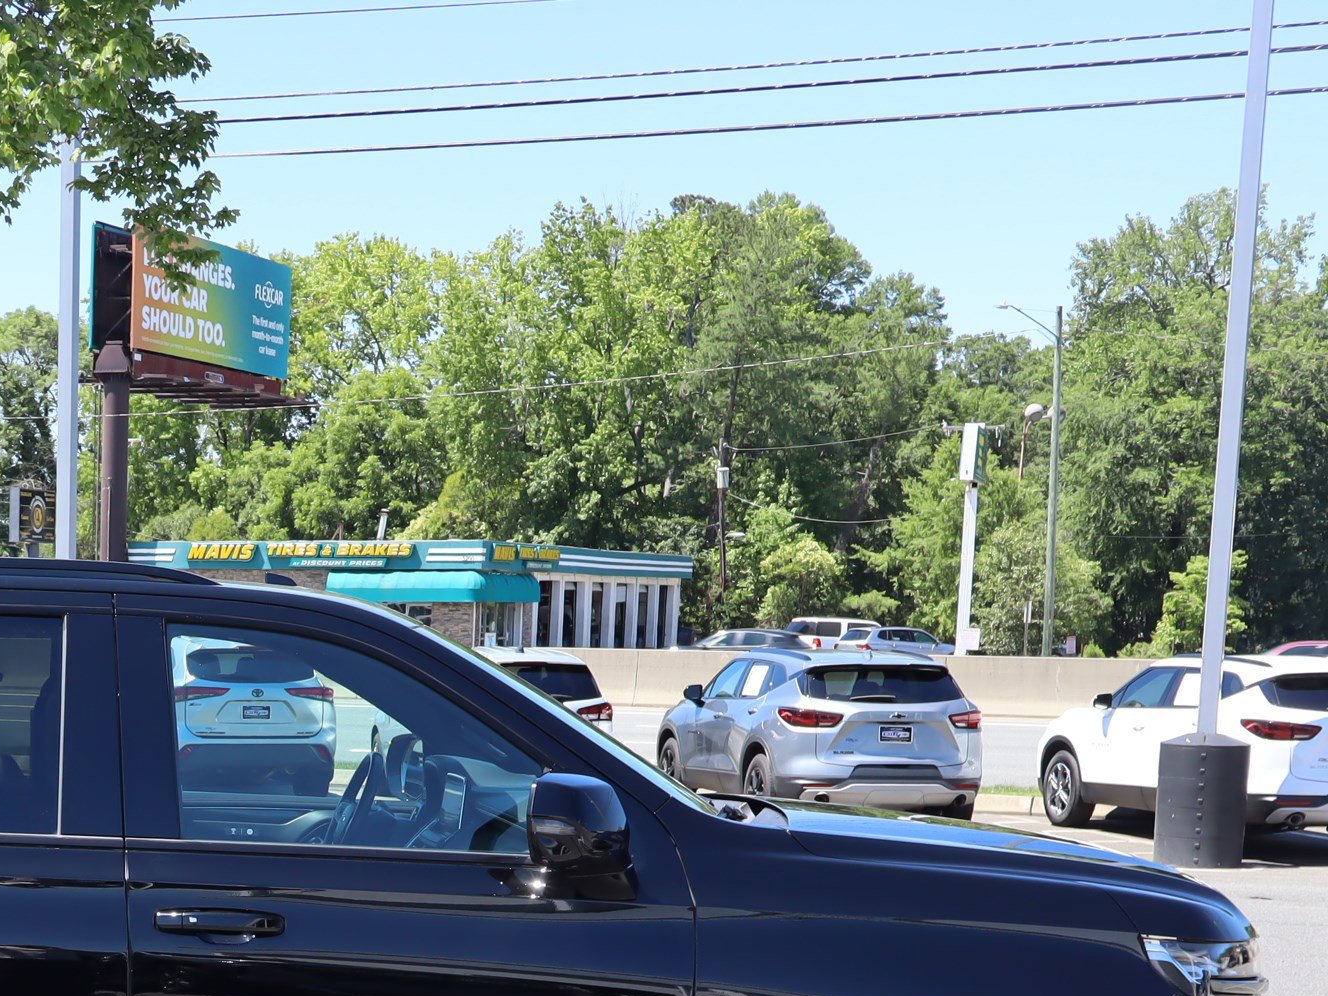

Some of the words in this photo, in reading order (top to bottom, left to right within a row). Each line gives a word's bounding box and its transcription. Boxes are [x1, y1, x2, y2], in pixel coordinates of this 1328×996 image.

[175, 257, 235, 290] HANGES.
[143, 273, 179, 305] YOUR
[255, 283, 283, 306] FLEXCAR
[142, 305, 195, 339] SHOULD
[197, 319, 226, 347] TOO.
[188, 543, 256, 560] MAVIS
[267, 543, 319, 556] TIRES
[320, 544, 332, 556] &
[336, 543, 412, 557] BRAKES
[349, 559, 384, 567] PRICES
